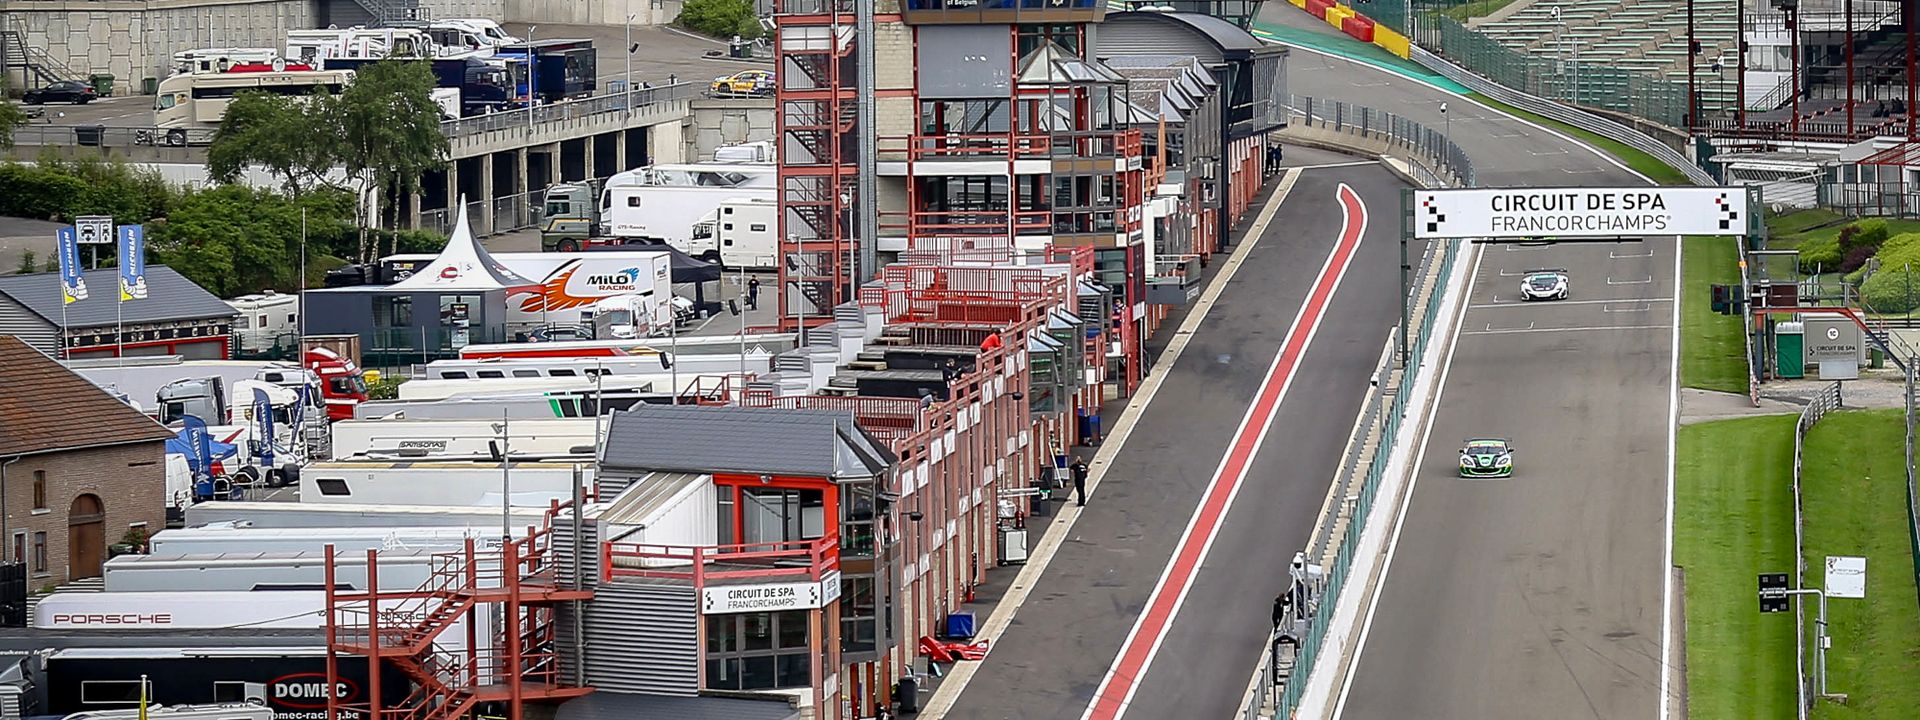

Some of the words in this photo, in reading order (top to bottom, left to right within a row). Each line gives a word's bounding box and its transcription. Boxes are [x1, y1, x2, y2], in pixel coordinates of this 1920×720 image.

[1491, 194, 1578, 211] CIRCUIT
[1587, 194, 1615, 210] DE
[1622, 193, 1666, 210] SPA
[64, 231, 76, 277] MICHELIN
[128, 229, 136, 275] MICHELIN
[728, 589, 762, 599] CIRCUIT
[764, 589, 776, 597] DE
[778, 587, 795, 596] SPA
[54, 614, 171, 624] PORSCHE
[275, 683, 347, 698] DOMEC
